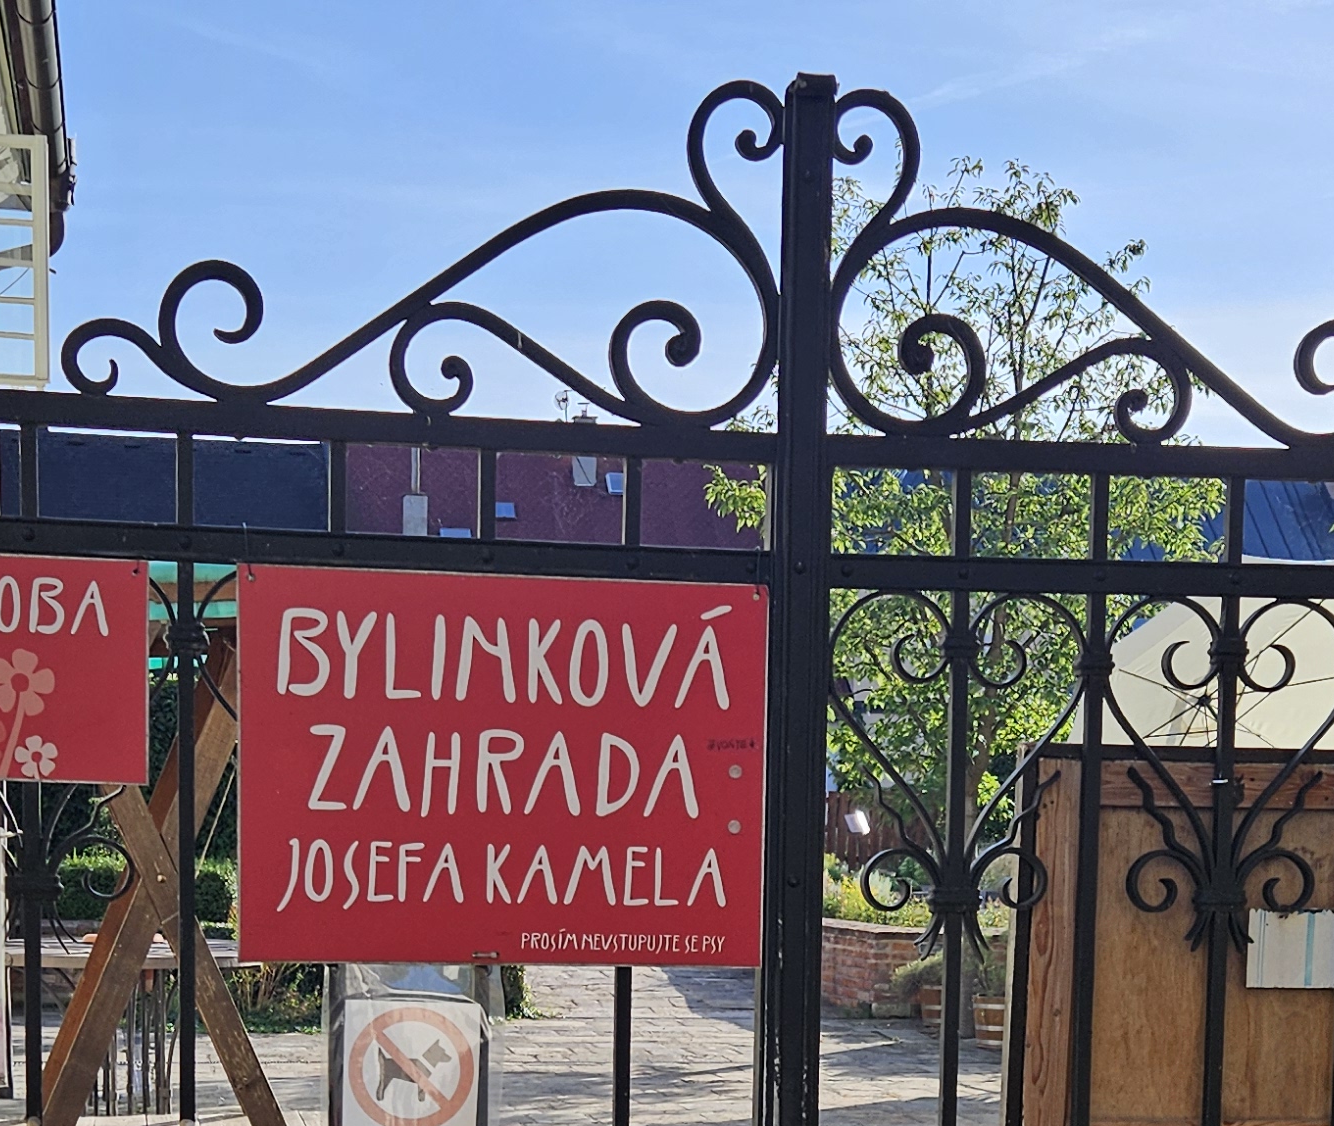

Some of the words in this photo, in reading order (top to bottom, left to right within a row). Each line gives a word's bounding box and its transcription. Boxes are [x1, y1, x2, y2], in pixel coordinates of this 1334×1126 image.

[276, 605, 733, 711] BYLINKOVÁ
[307, 723, 699, 819] ZAHRADA
[276, 837, 464, 912] JOSEFA
[486, 843, 727, 908] KAMELA
[520, 928, 578, 952] PROSÍM
[581, 933, 680, 954] NEVSTUPUJTE
[684, 935, 699, 954] SE
[702, 935, 726, 954] PSY
